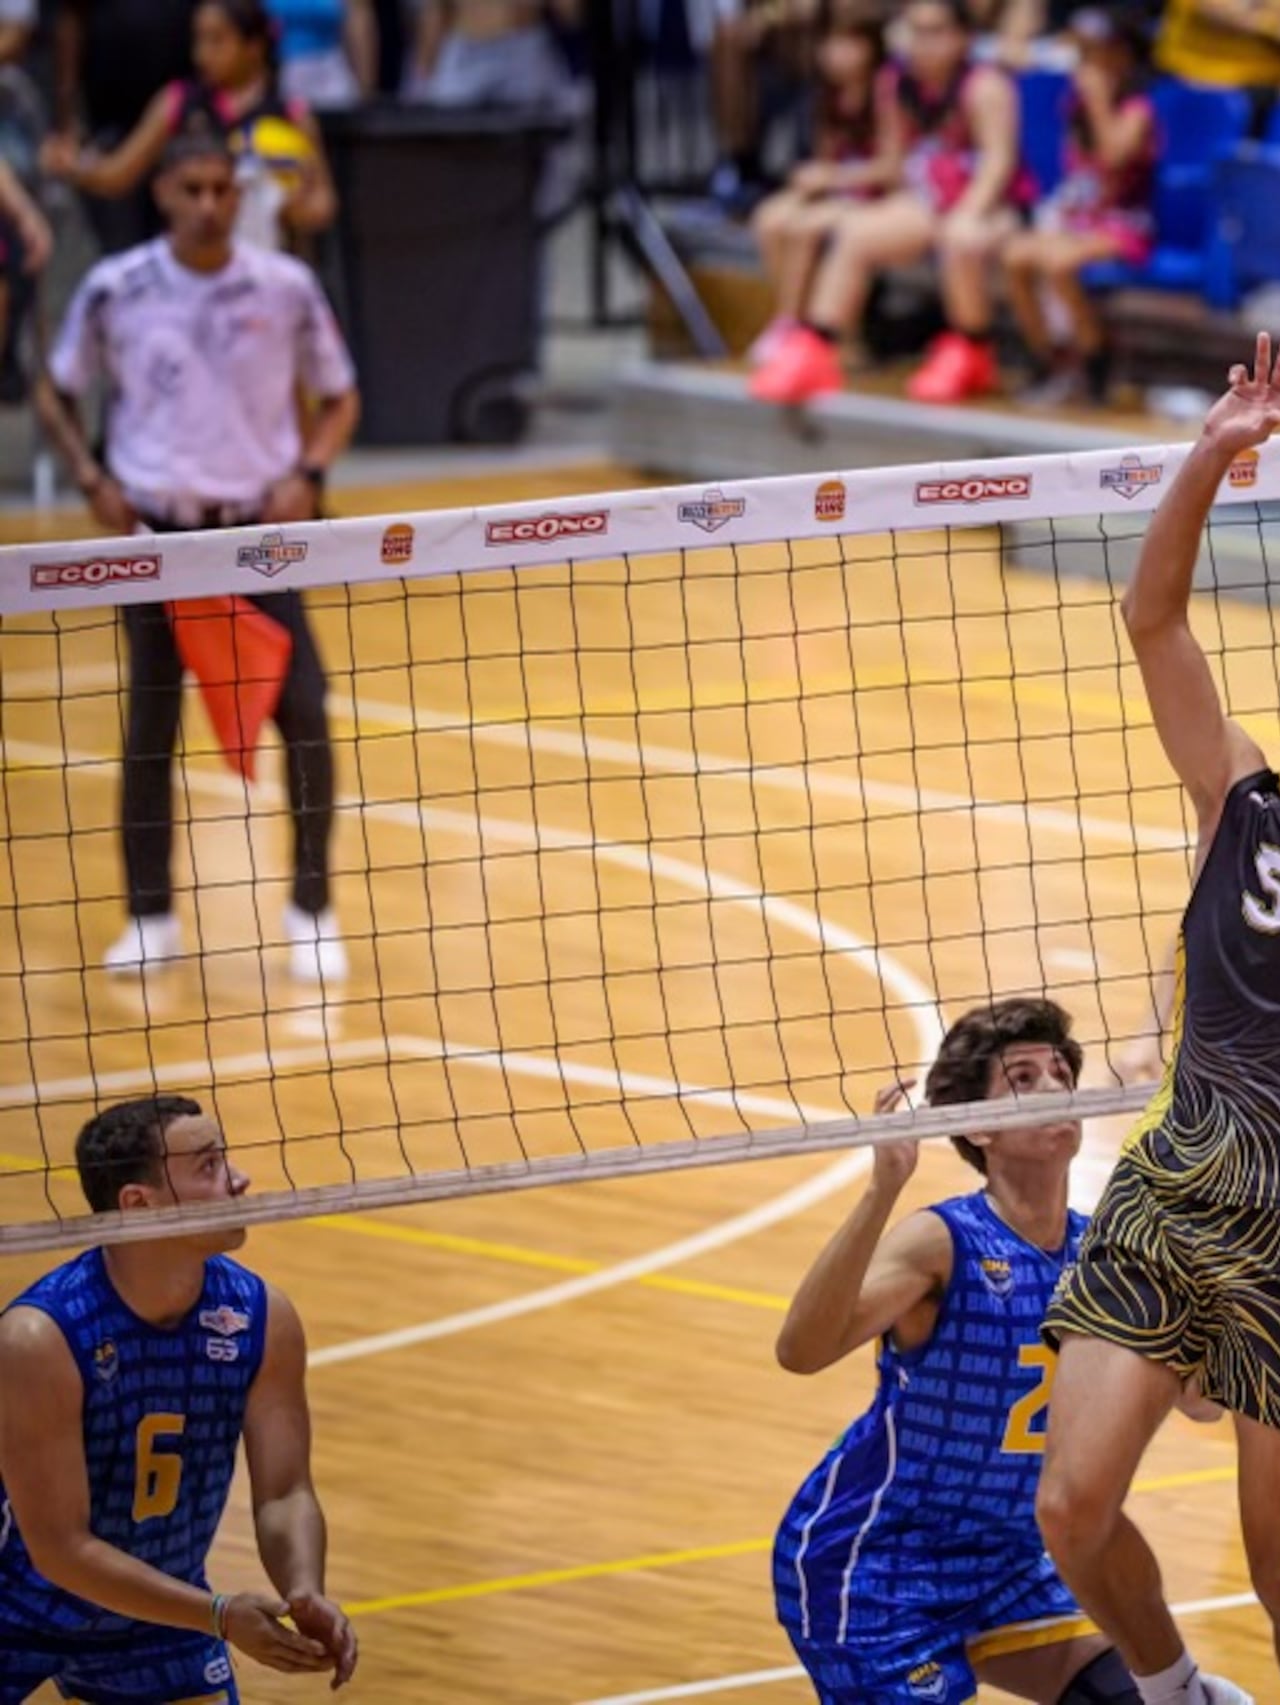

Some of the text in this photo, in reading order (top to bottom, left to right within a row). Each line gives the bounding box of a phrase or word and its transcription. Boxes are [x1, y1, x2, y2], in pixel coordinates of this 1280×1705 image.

[919, 480, 1026, 499] ECONO
[815, 501, 846, 514] KING
[491, 516, 603, 539] ECONO
[36, 560, 156, 583] ECONO
[1000, 1344, 1060, 1453] 2
[132, 1412, 187, 1524] 6
